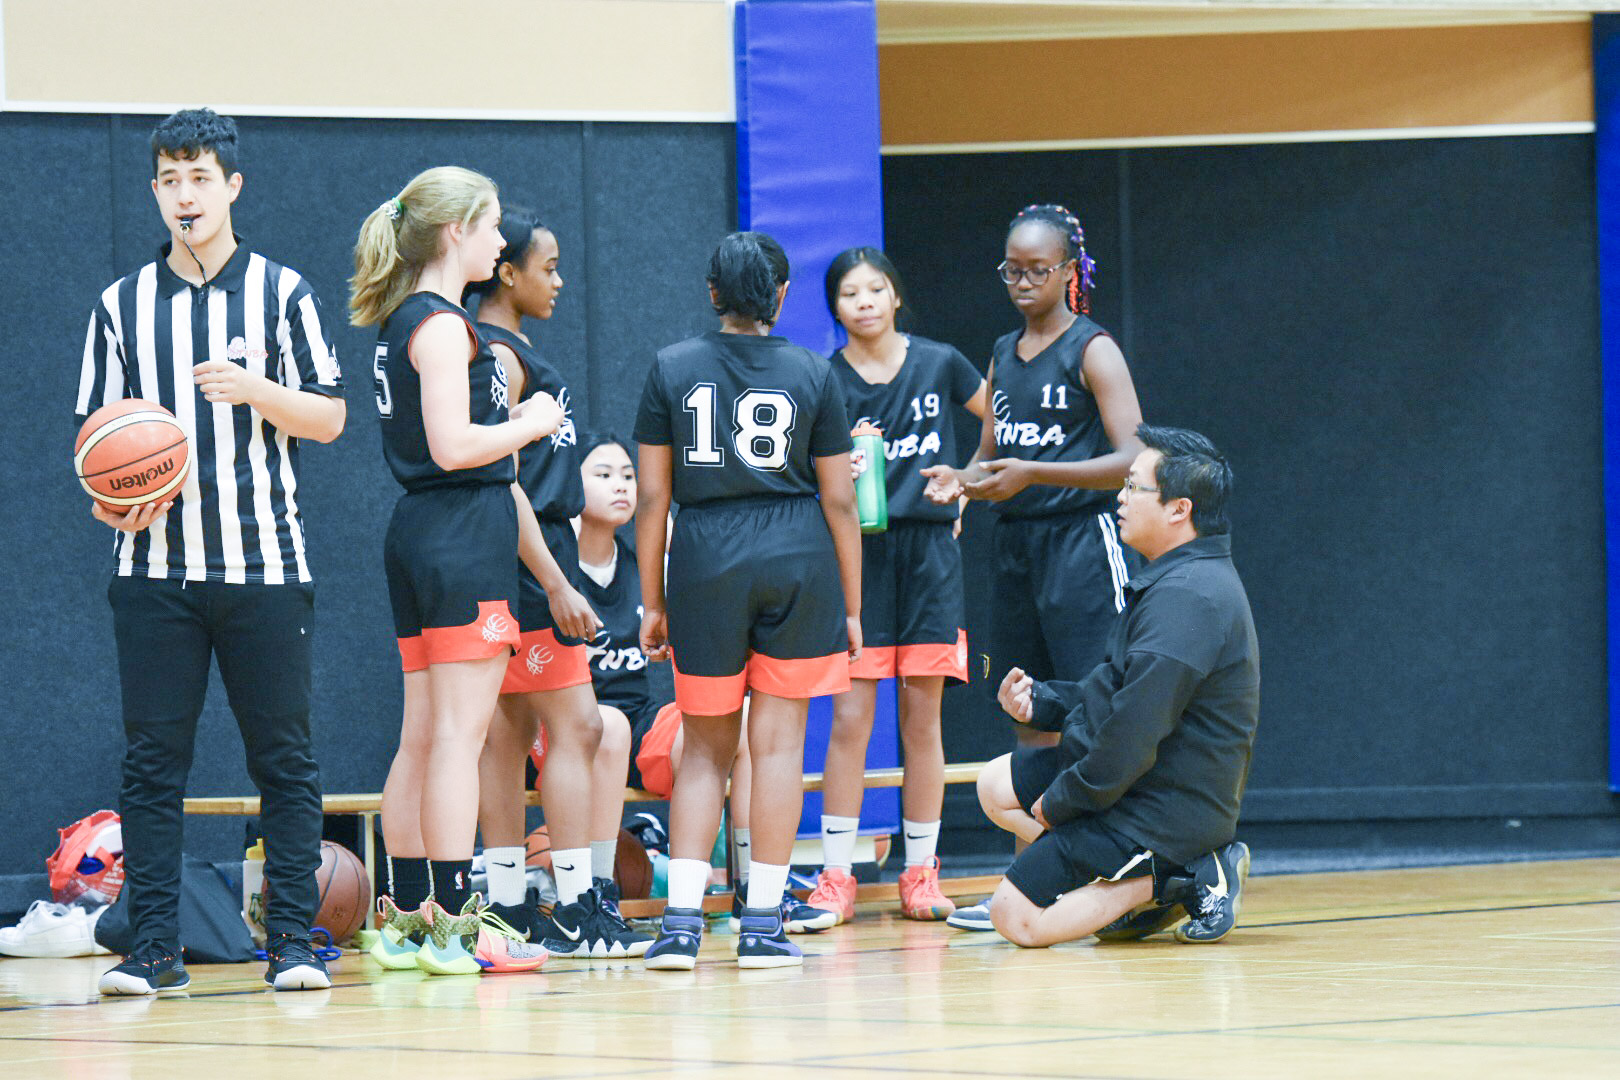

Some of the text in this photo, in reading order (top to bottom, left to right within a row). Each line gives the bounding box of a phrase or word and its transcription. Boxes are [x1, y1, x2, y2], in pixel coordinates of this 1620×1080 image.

[373, 341, 394, 419] 5
[1040, 383, 1068, 409] 11
[911, 393, 940, 421] 19
[682, 382, 798, 472] 18
[108, 457, 174, 491] molten
